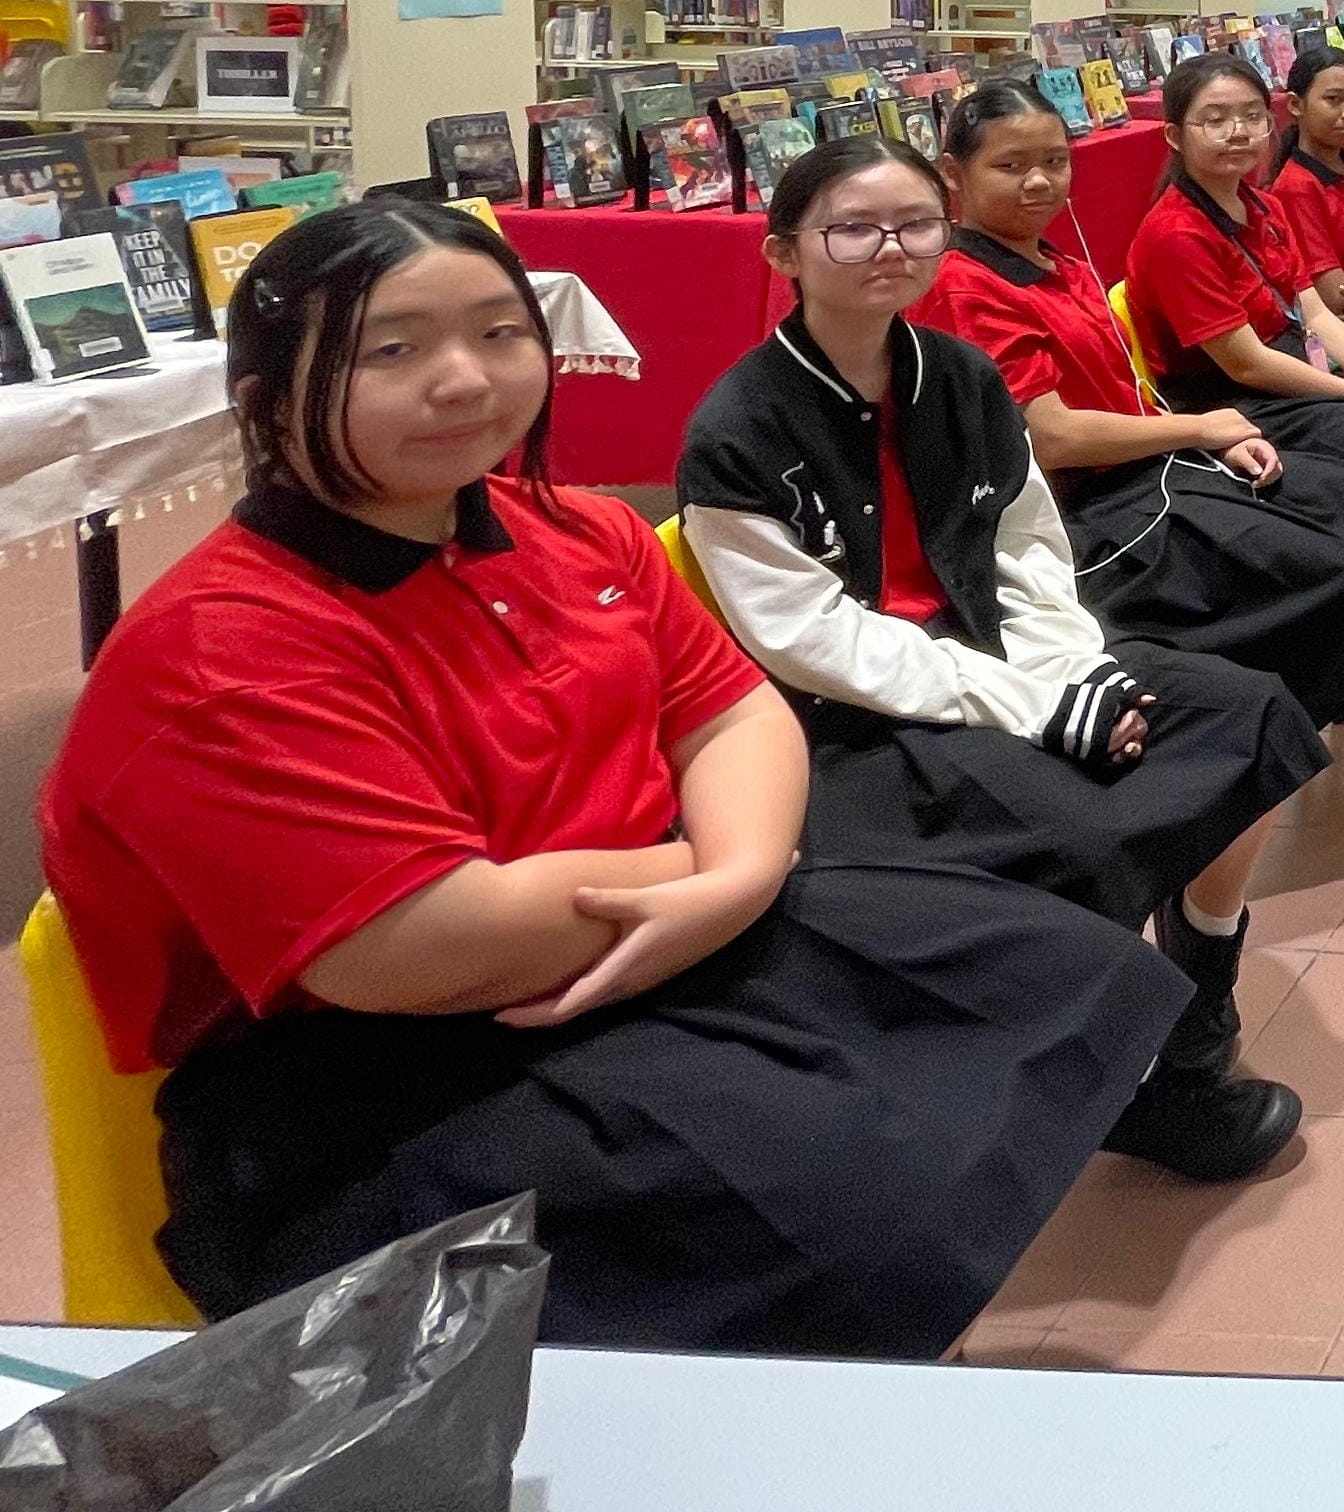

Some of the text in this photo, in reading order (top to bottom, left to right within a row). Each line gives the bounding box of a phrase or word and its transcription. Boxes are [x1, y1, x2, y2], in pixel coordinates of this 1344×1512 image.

[216, 68, 278, 80] THRILLER
[122, 231, 161, 251] KEEP
[213, 241, 265, 265] DO
[140, 264, 167, 283] THE
